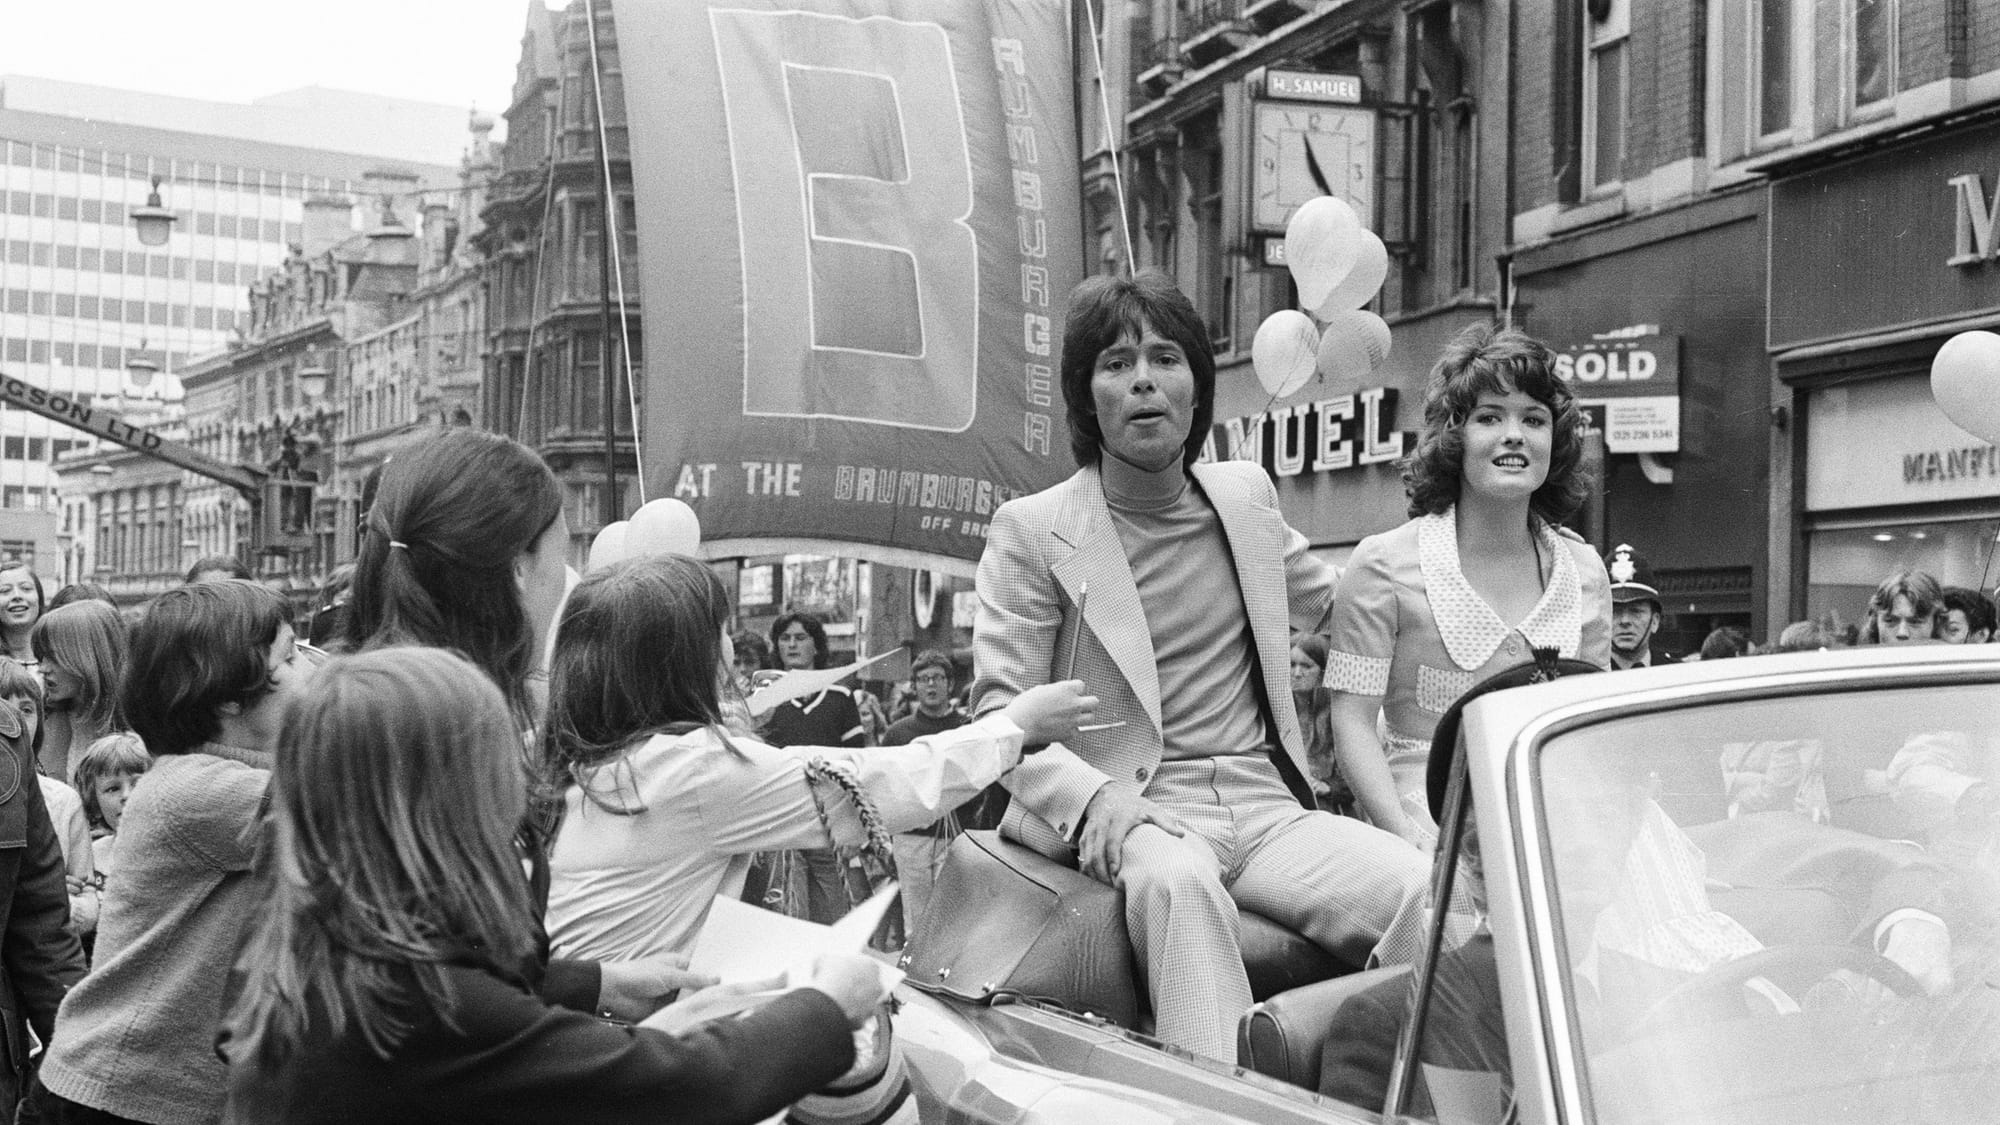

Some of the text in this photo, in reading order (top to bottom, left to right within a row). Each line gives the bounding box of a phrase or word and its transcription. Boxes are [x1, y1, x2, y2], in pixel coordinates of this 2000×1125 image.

[1272, 77, 1357, 98] H. SAMUEL
[707, 6, 979, 434] B
[1552, 351, 1657, 382] SOLD
[0, 374, 162, 450] GSON LTD
[674, 463, 717, 498] AT
[741, 461, 803, 497] THE
[1902, 445, 2000, 484] MANFI
[920, 515, 952, 530] OFF
